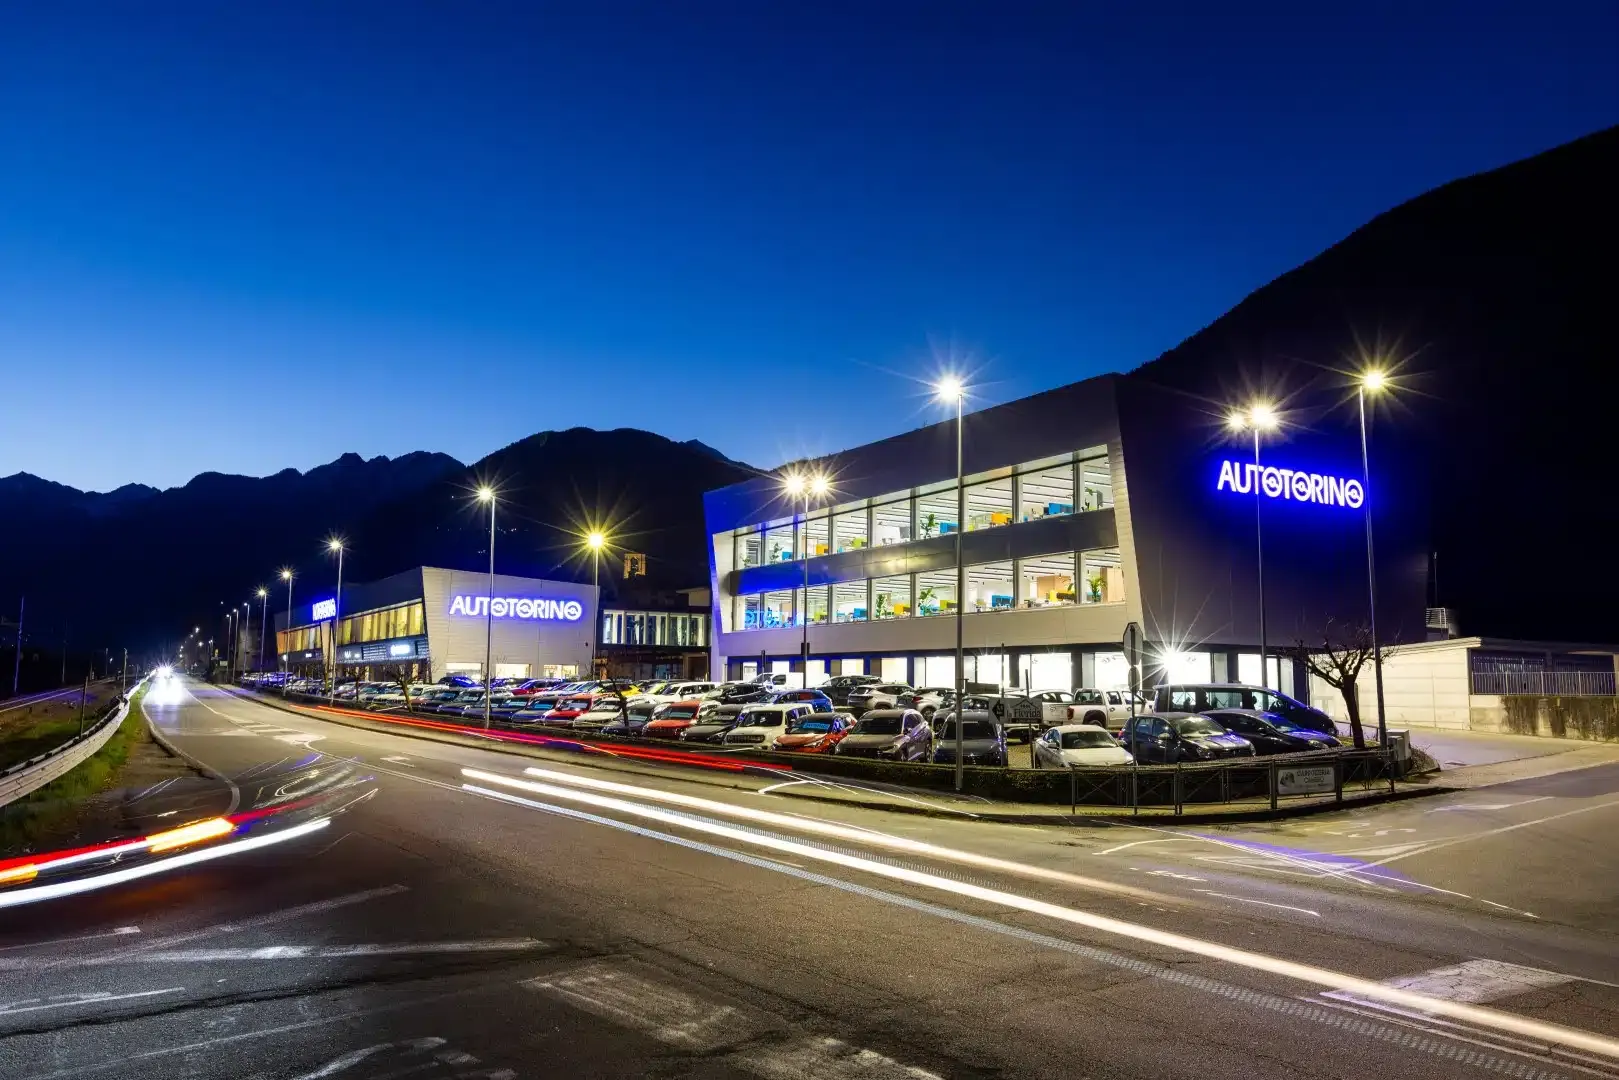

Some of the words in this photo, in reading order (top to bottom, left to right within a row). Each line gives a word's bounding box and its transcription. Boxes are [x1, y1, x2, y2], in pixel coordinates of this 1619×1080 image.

[1217, 460, 1364, 508] AUTOTORINO
[449, 595, 582, 620] AUTOTORINO
[1014, 708, 1041, 717] Florida
